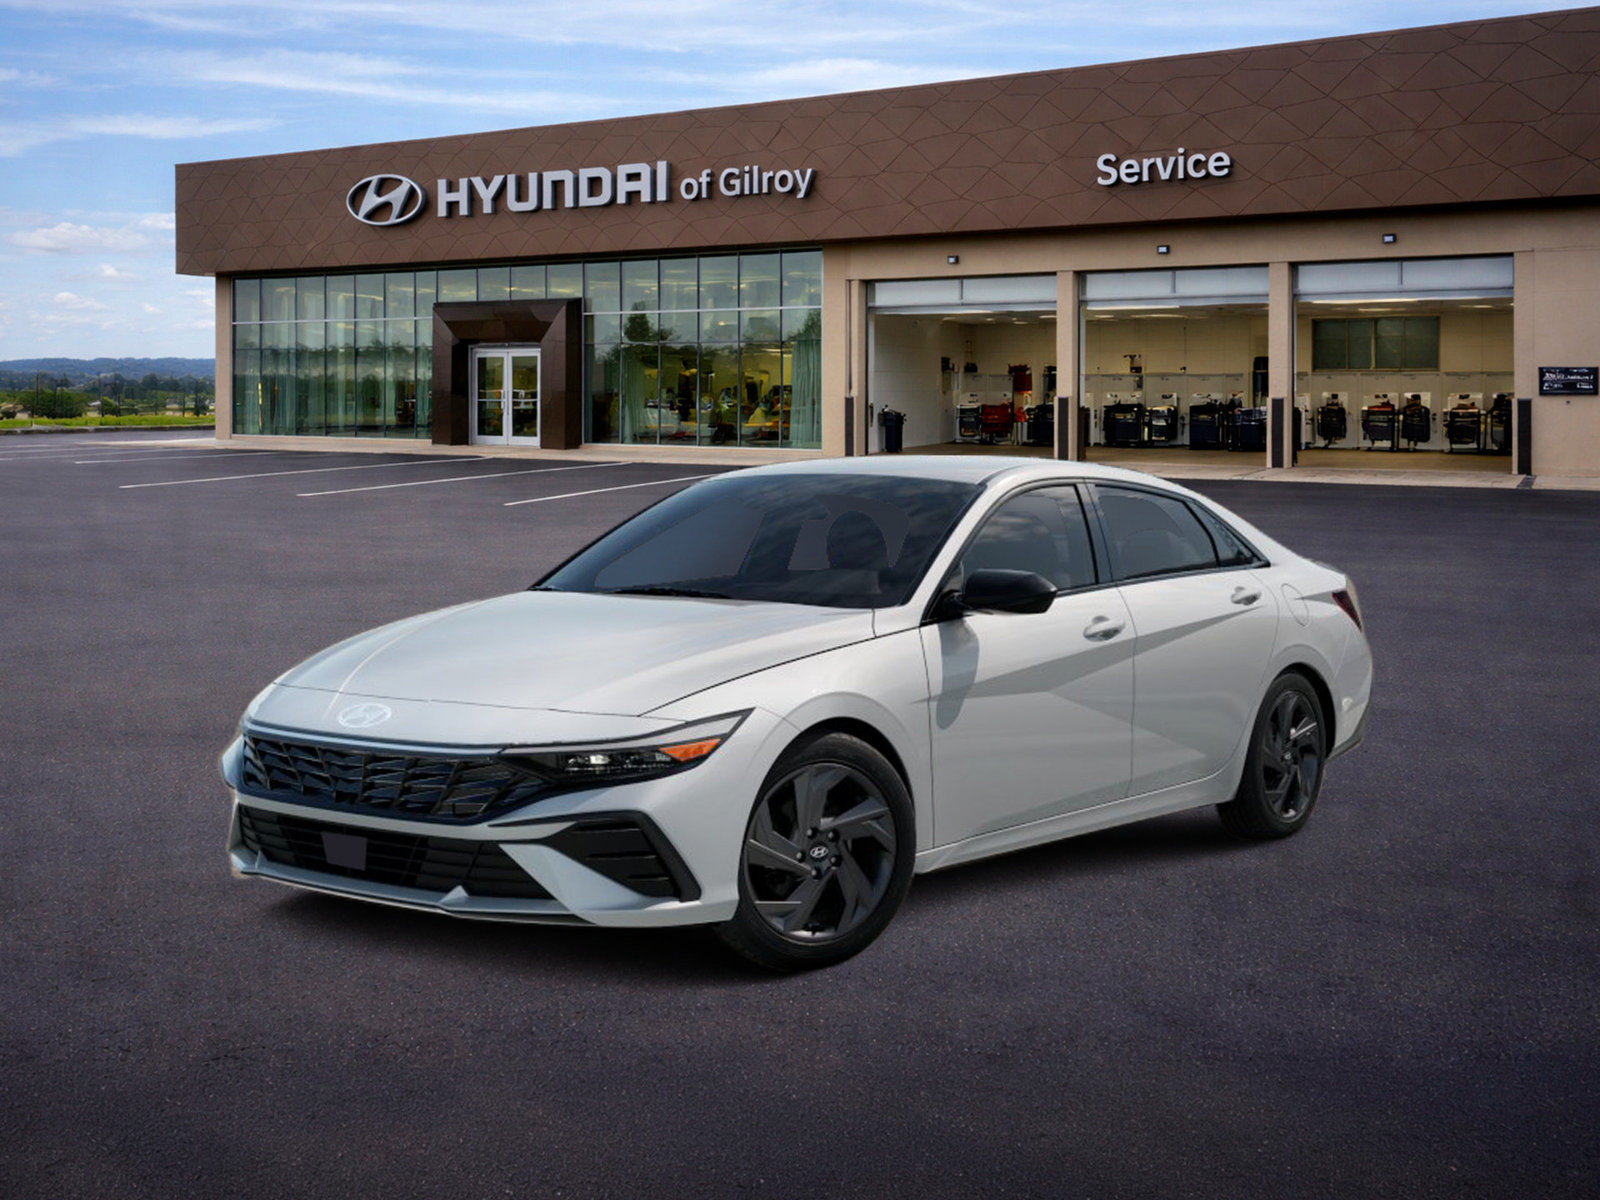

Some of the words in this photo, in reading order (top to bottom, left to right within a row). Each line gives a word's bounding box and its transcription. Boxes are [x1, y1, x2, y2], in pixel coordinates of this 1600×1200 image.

[437, 160, 670, 217] HYUNDAI
[680, 169, 711, 200] of
[718, 165, 814, 199] Gilroy
[1096, 147, 1232, 186] Service
